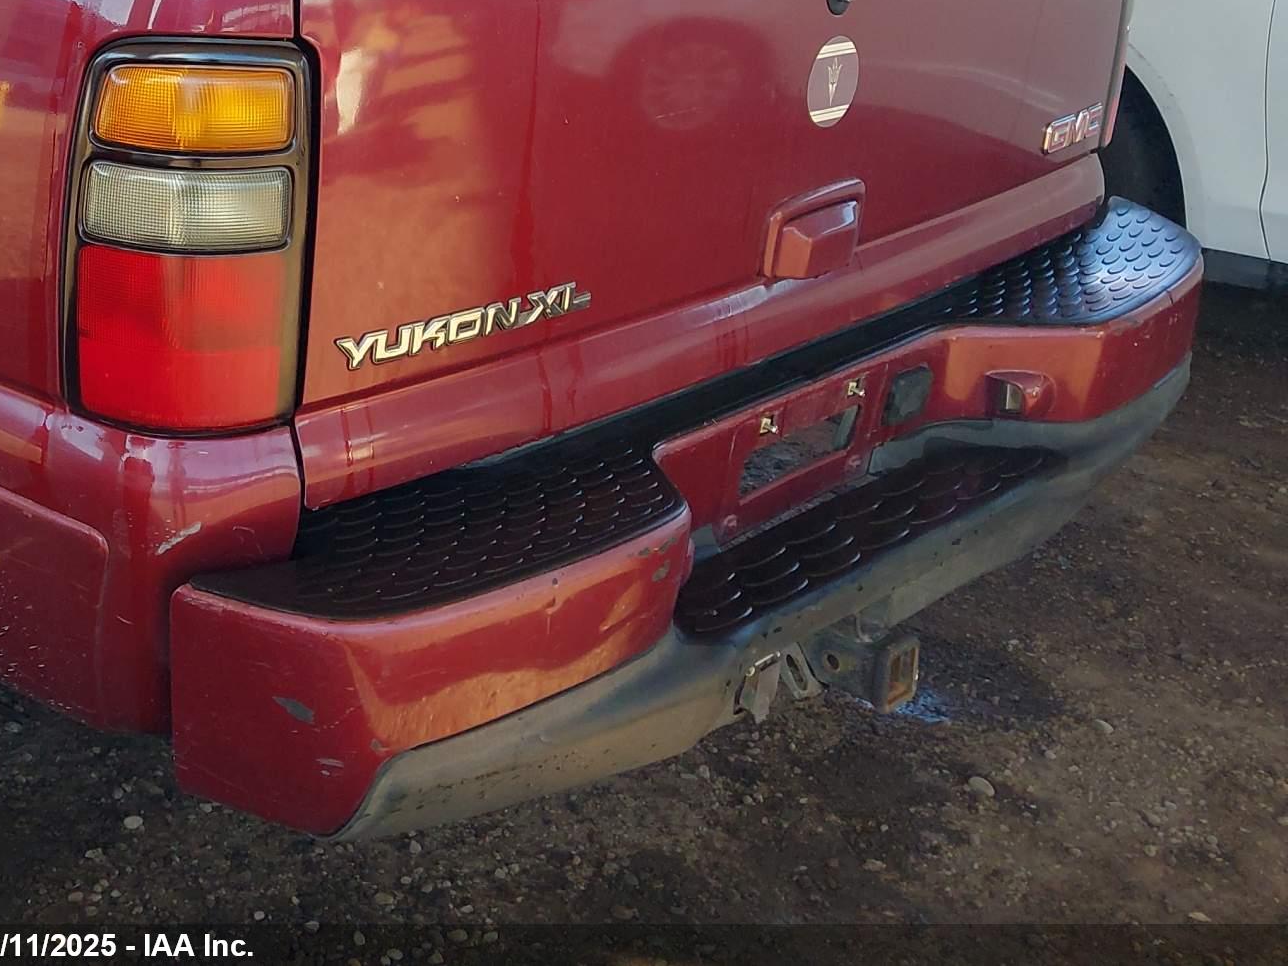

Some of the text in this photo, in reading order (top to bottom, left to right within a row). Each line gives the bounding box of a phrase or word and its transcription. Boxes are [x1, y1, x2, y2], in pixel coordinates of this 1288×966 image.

[1042, 102, 1103, 154] GMC
[334, 281, 592, 371] YUKON XL
